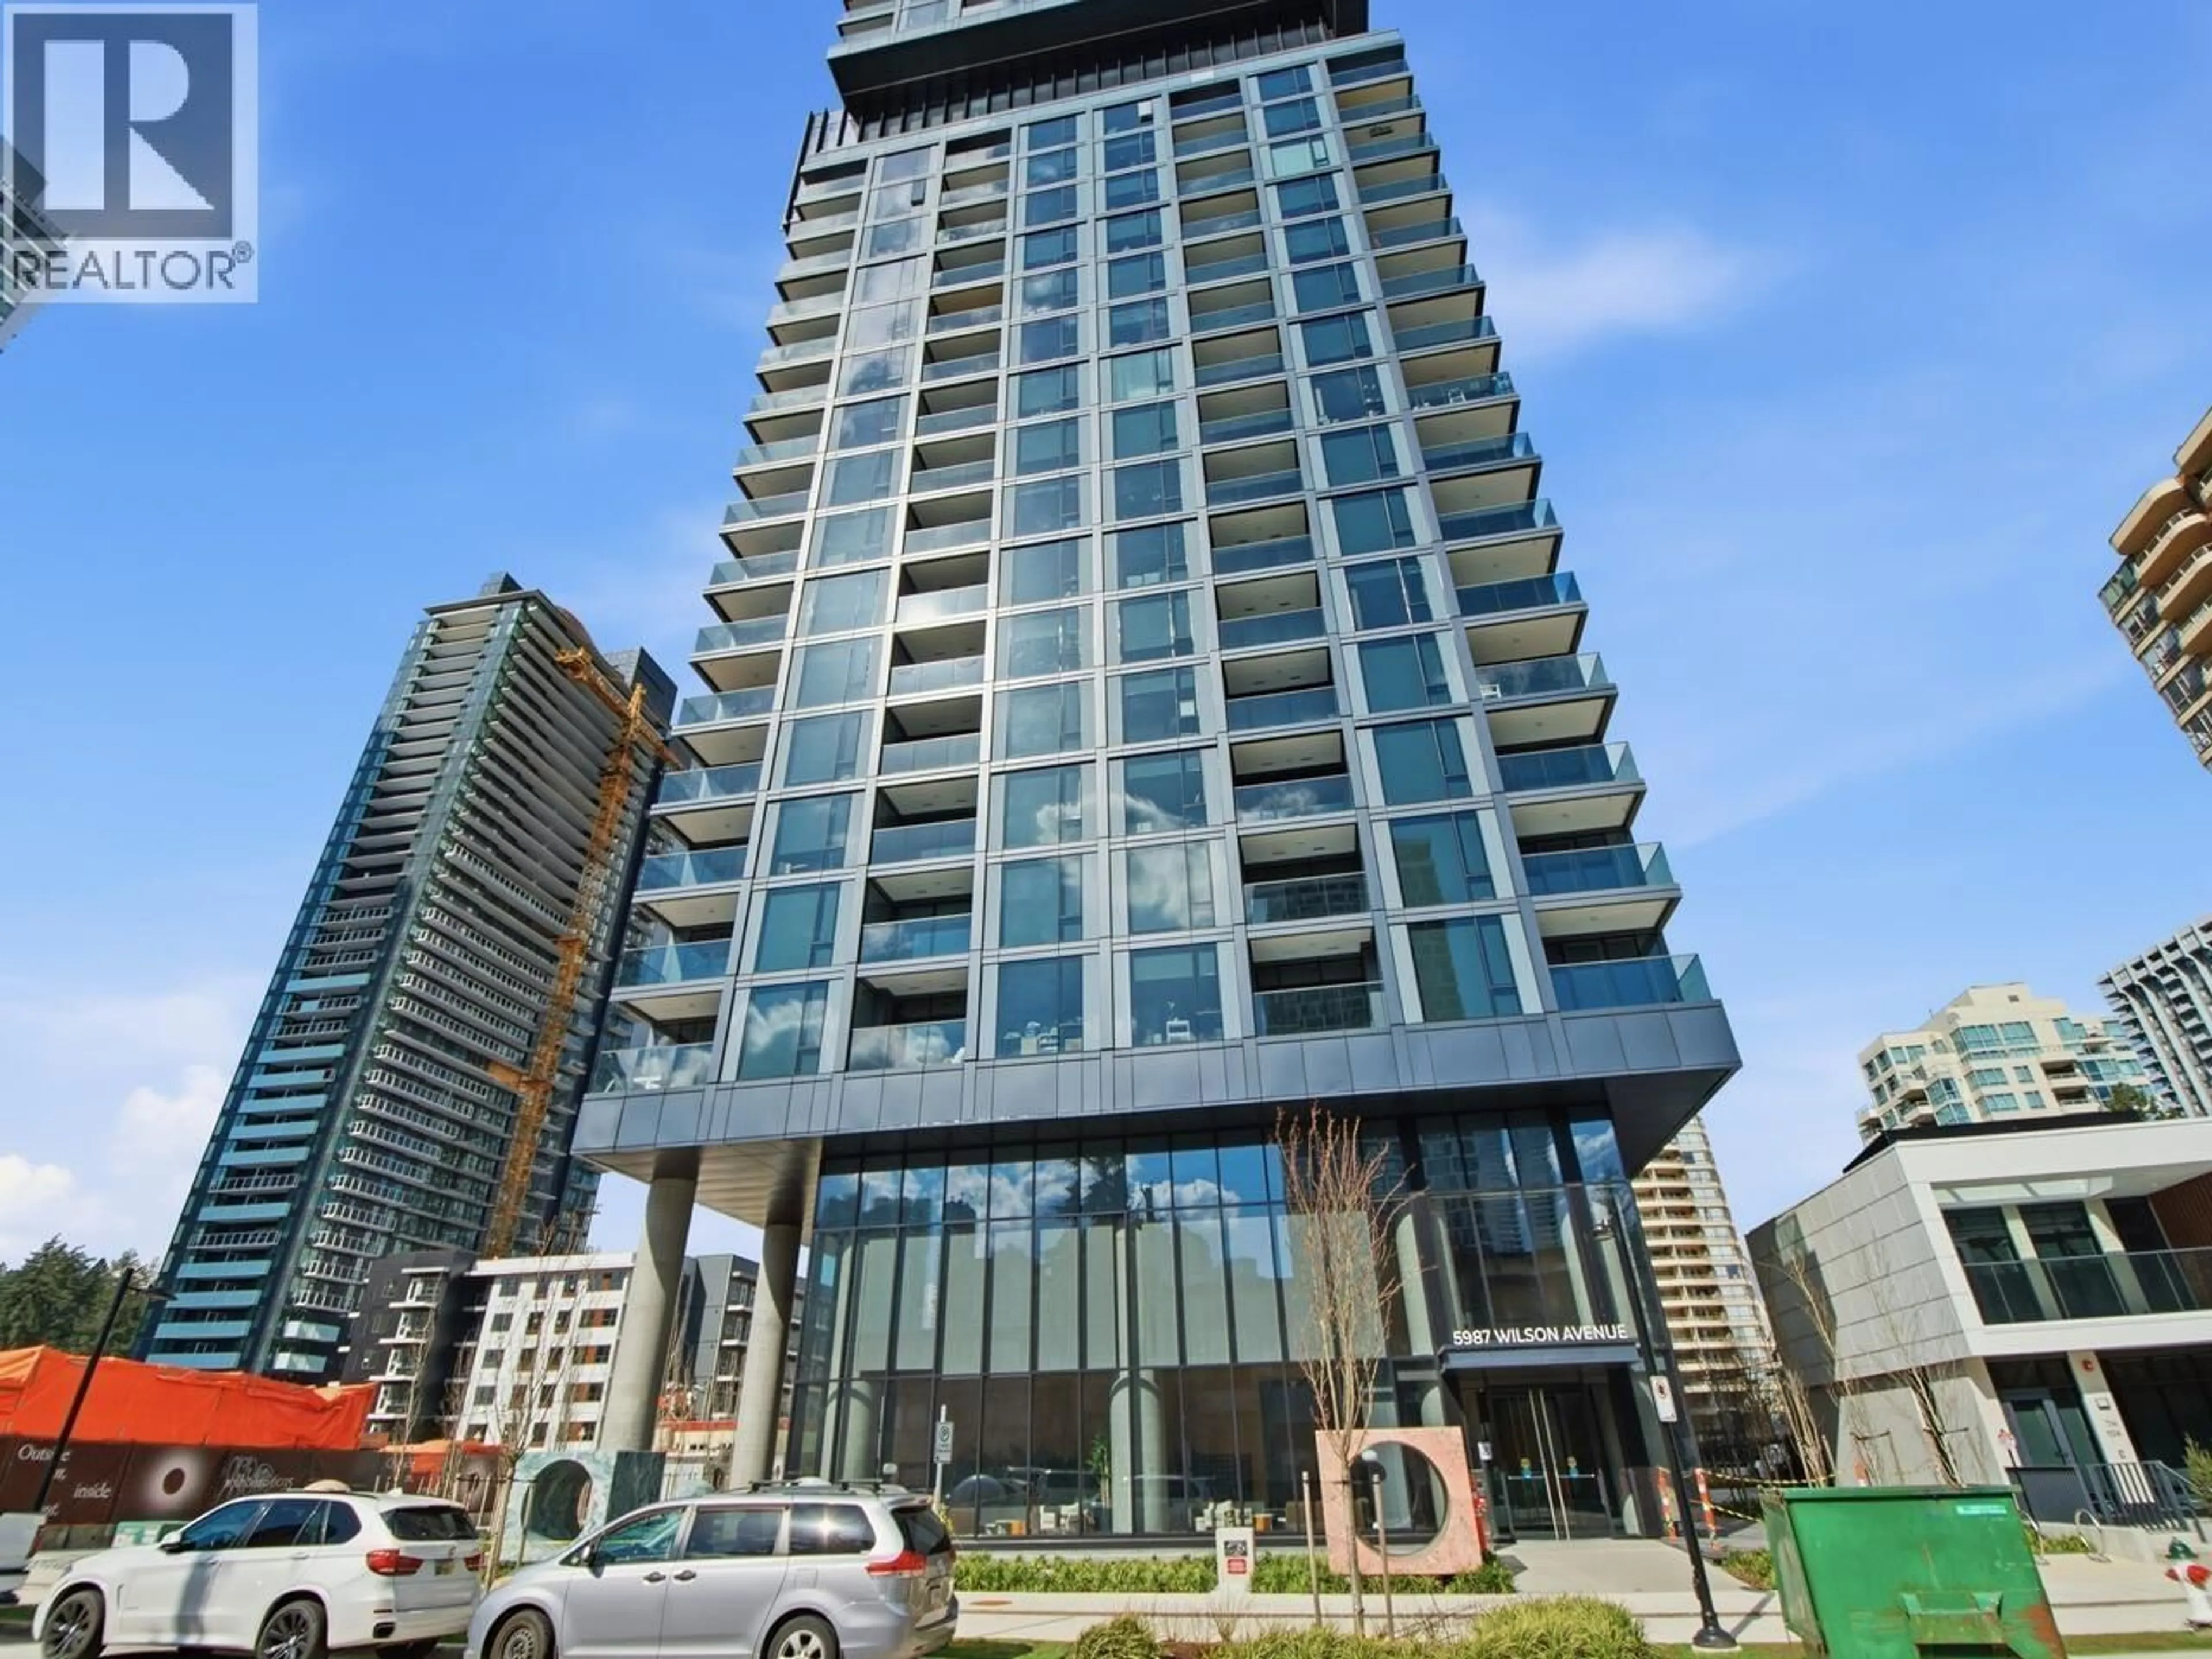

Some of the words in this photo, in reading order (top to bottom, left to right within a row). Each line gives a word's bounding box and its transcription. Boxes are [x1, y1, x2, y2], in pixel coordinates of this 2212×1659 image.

[1453, 1328, 1491, 1346] 5987
[1493, 1327, 1559, 1343] WILSON
[1562, 1324, 1628, 1341] AVENUE
